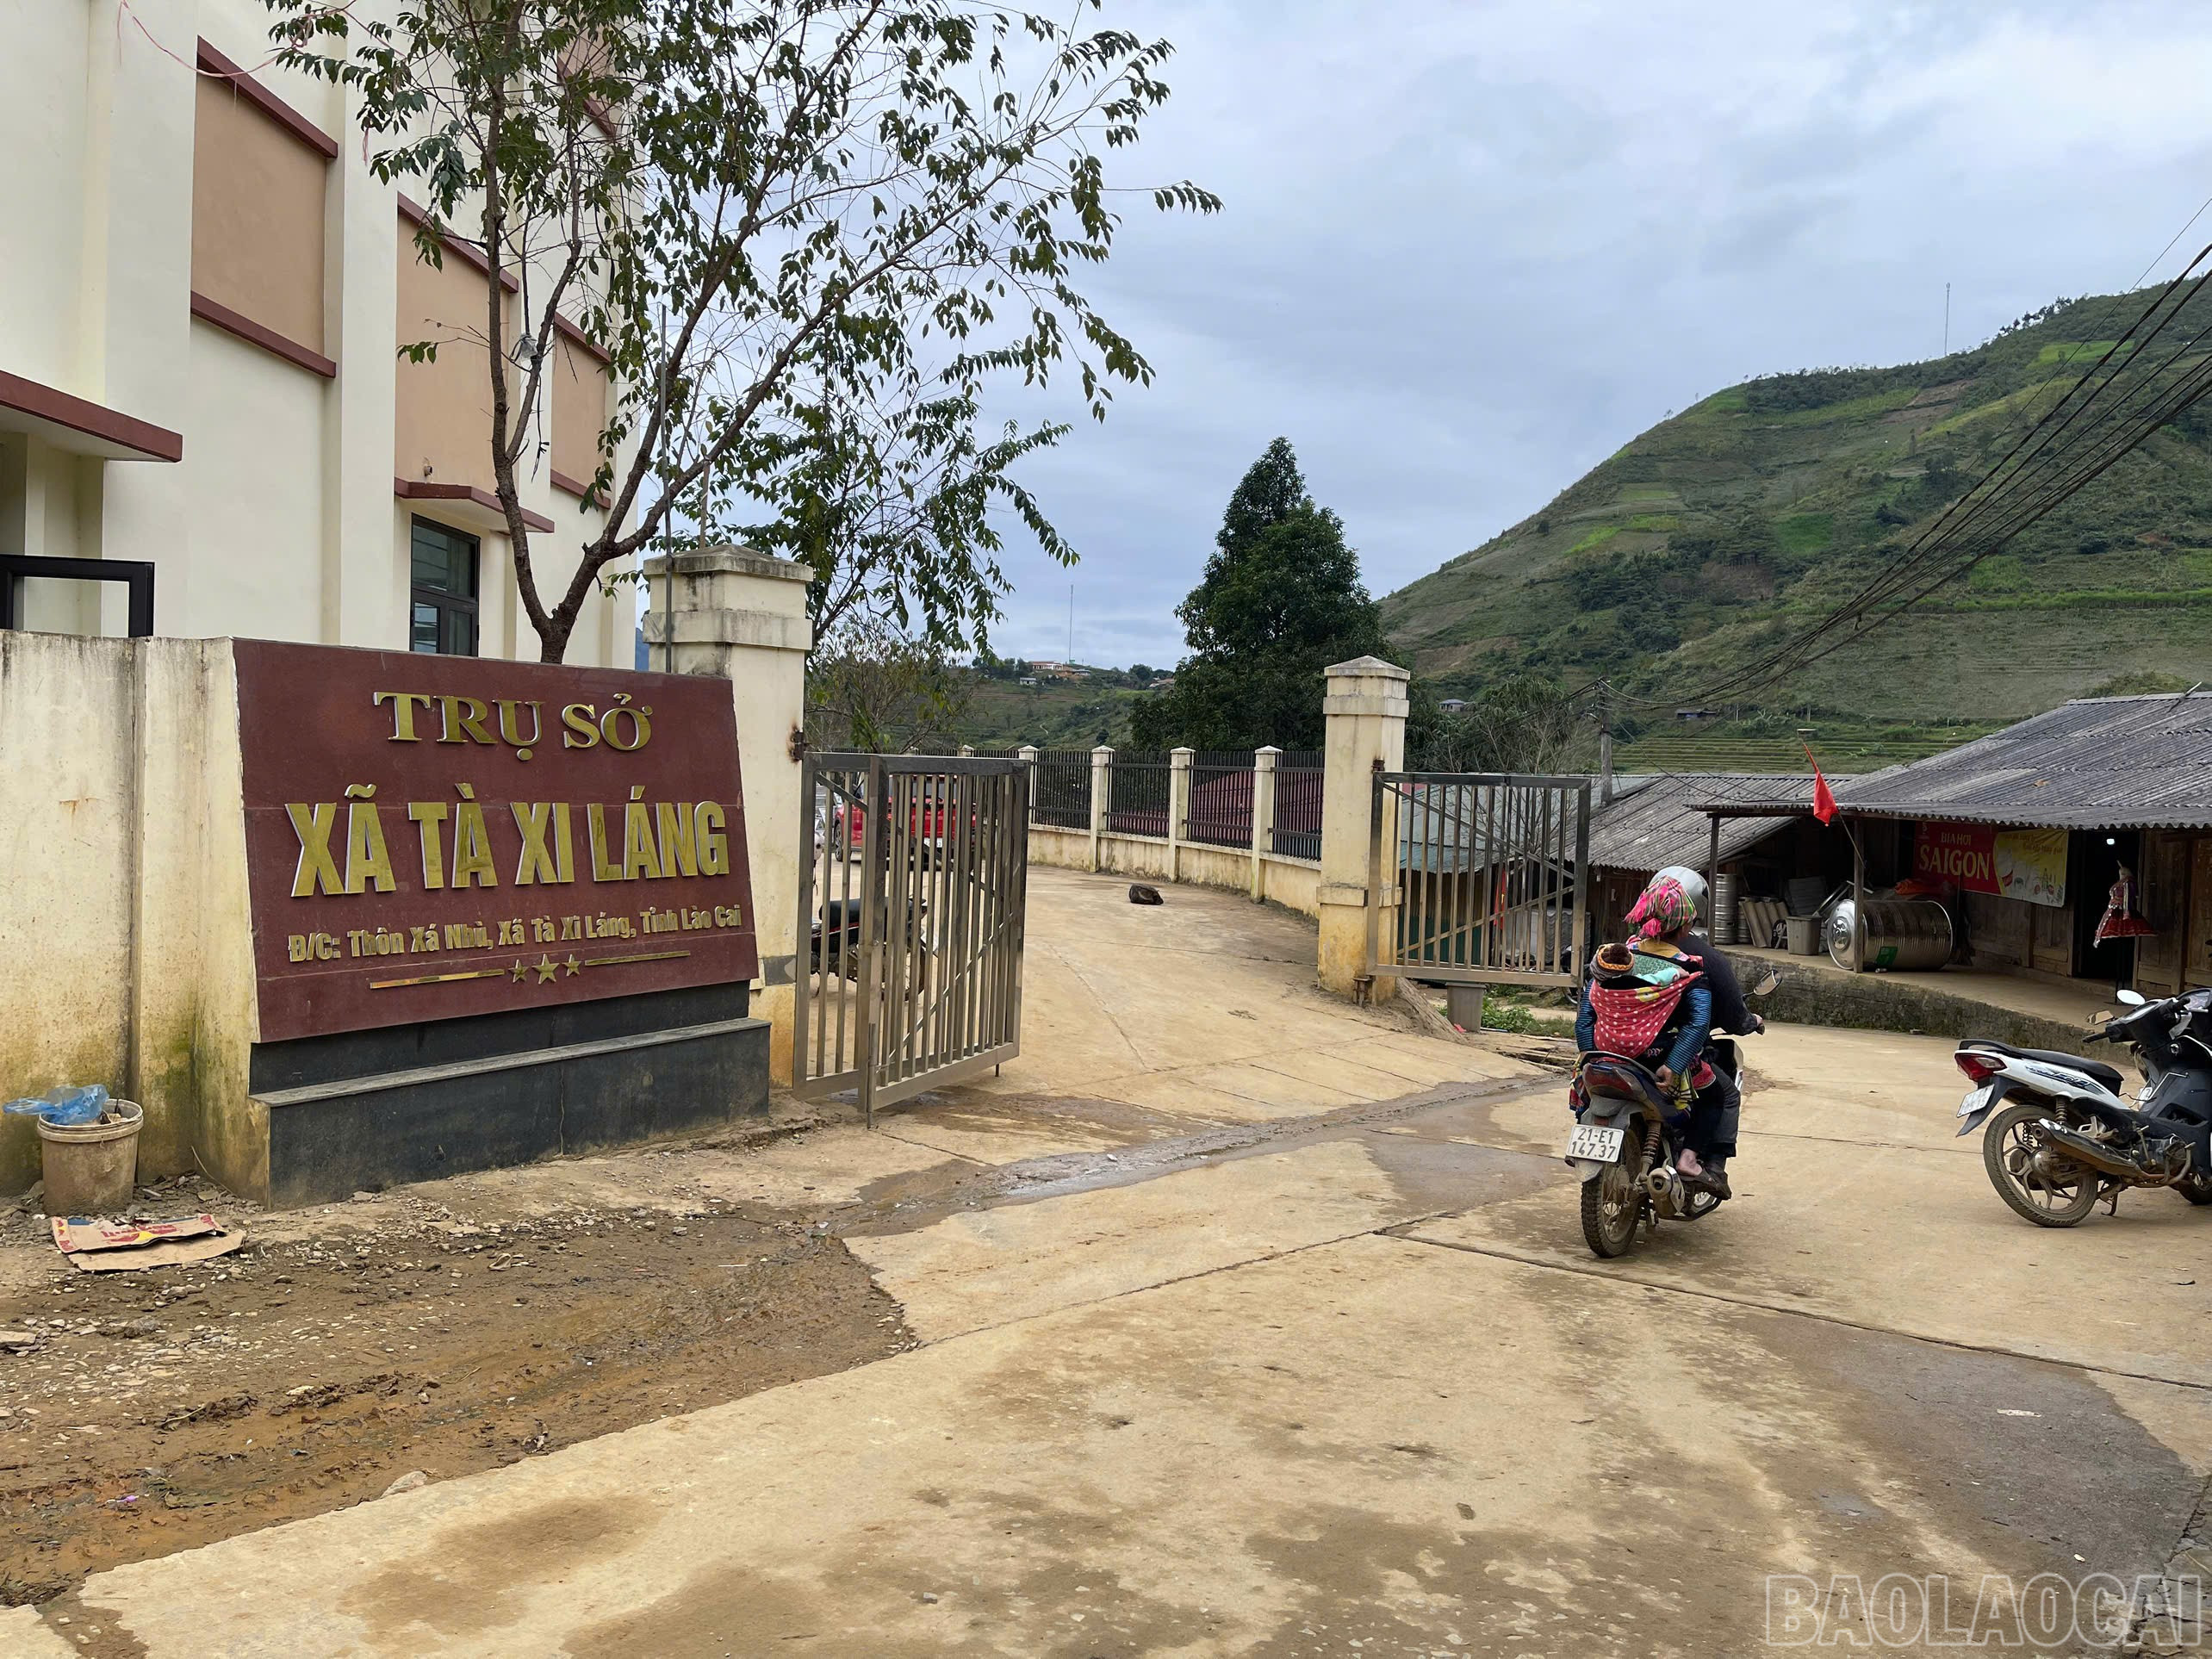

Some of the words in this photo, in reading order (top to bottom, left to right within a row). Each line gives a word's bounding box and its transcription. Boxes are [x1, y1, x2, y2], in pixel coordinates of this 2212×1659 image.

[373, 691, 544, 761] TRỤ
[562, 693, 653, 751] SỞ
[284, 783, 396, 898] XÃ
[408, 782, 499, 890] TÀ
[510, 801, 575, 885] XI
[587, 785, 730, 882] LÁNG
[1919, 844, 1991, 880] SAIGON
[288, 932, 341, 962] Đ/C:
[347, 927, 404, 957] Thôn
[409, 923, 440, 953] Xá
[497, 917, 525, 946] Xã
[531, 915, 556, 942] Tà
[561, 915, 581, 941] Xi
[585, 911, 637, 939] Láng,
[640, 907, 679, 934] Tỉnh
[680, 904, 711, 930] Lào
[714, 904, 742, 928] Cai
[1571, 1141, 1616, 1159] 147.37
[1578, 1128, 1614, 1144] 21-E1
